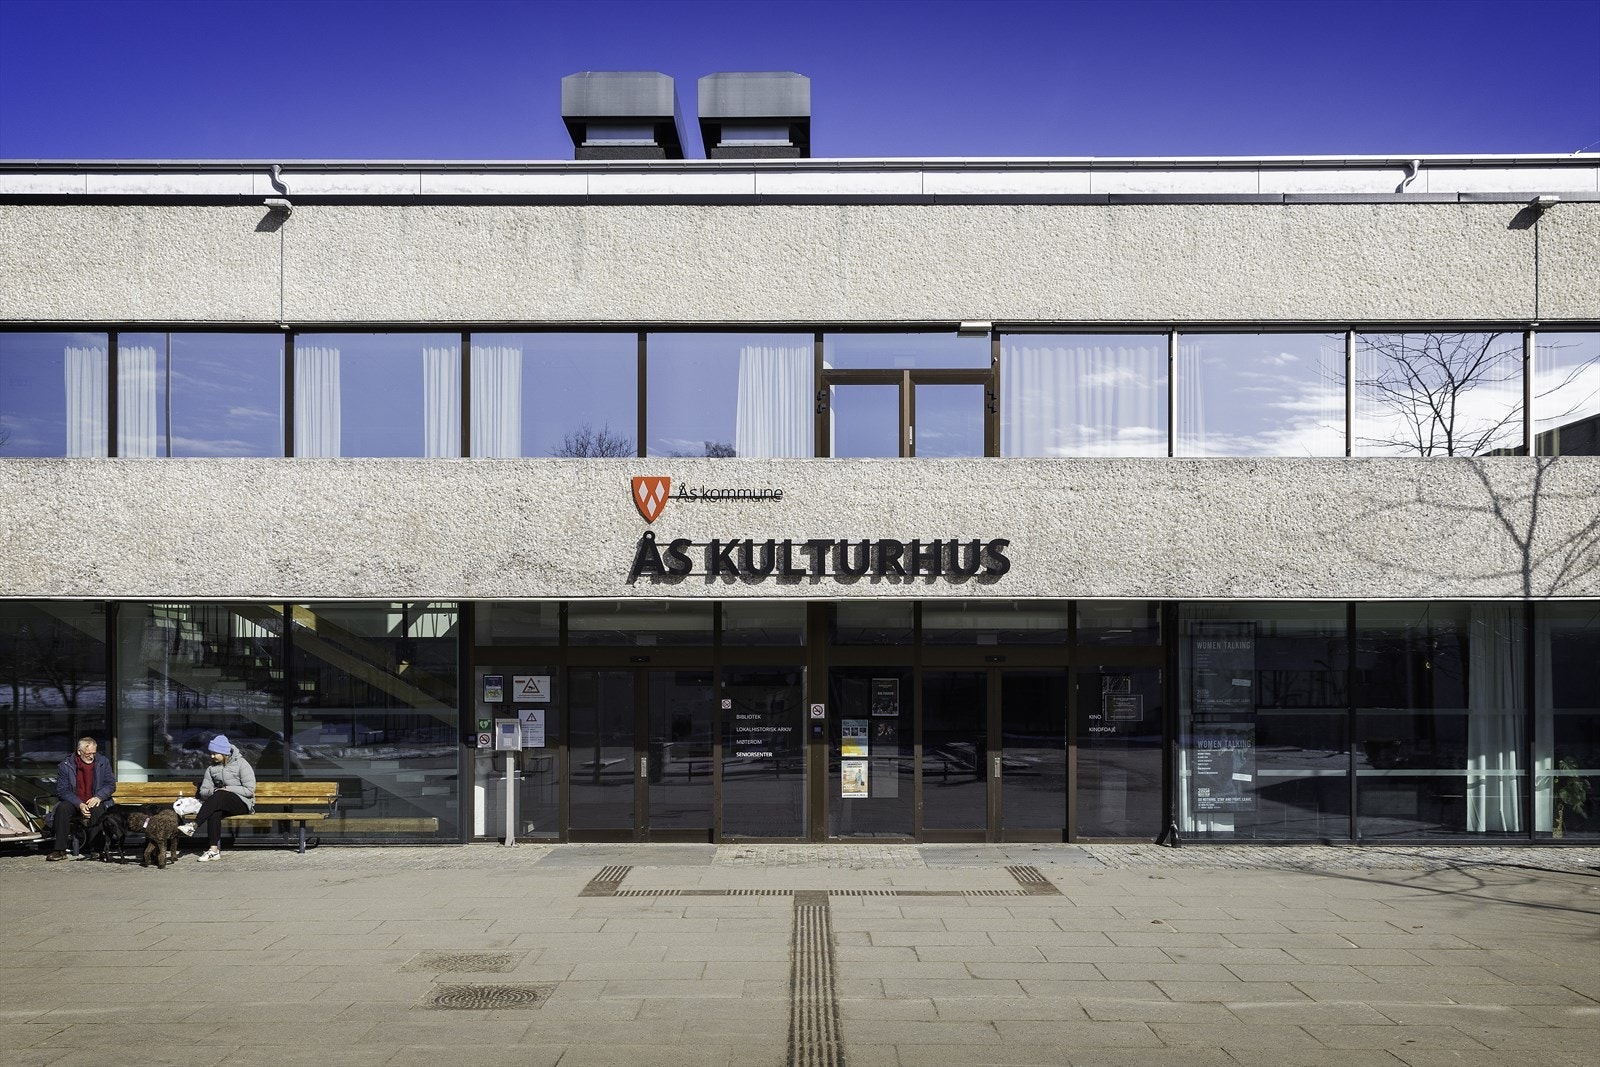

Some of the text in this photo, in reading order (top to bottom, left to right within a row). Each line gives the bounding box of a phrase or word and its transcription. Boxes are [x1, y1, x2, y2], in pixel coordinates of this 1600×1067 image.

[677, 482, 783, 499] Ås kommune
[632, 530, 1011, 576] ÅS KULTURHUS
